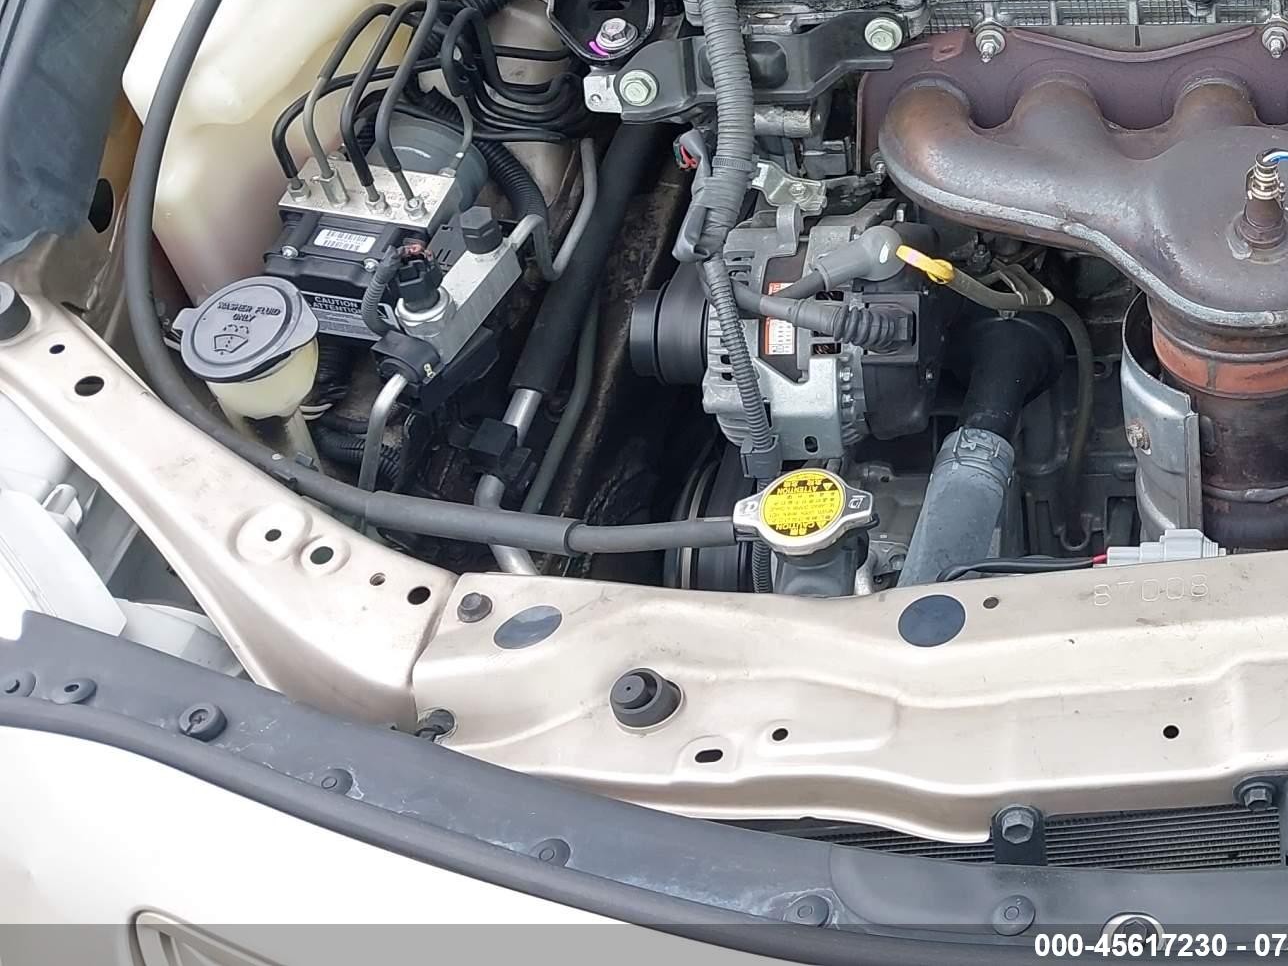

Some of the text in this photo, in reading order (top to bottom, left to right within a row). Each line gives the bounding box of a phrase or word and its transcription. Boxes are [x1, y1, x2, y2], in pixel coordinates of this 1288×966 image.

[314, 296, 358, 308] CAUTION
[217, 301, 281, 316] WASHER FLUID
[232, 314, 256, 322] ONLY
